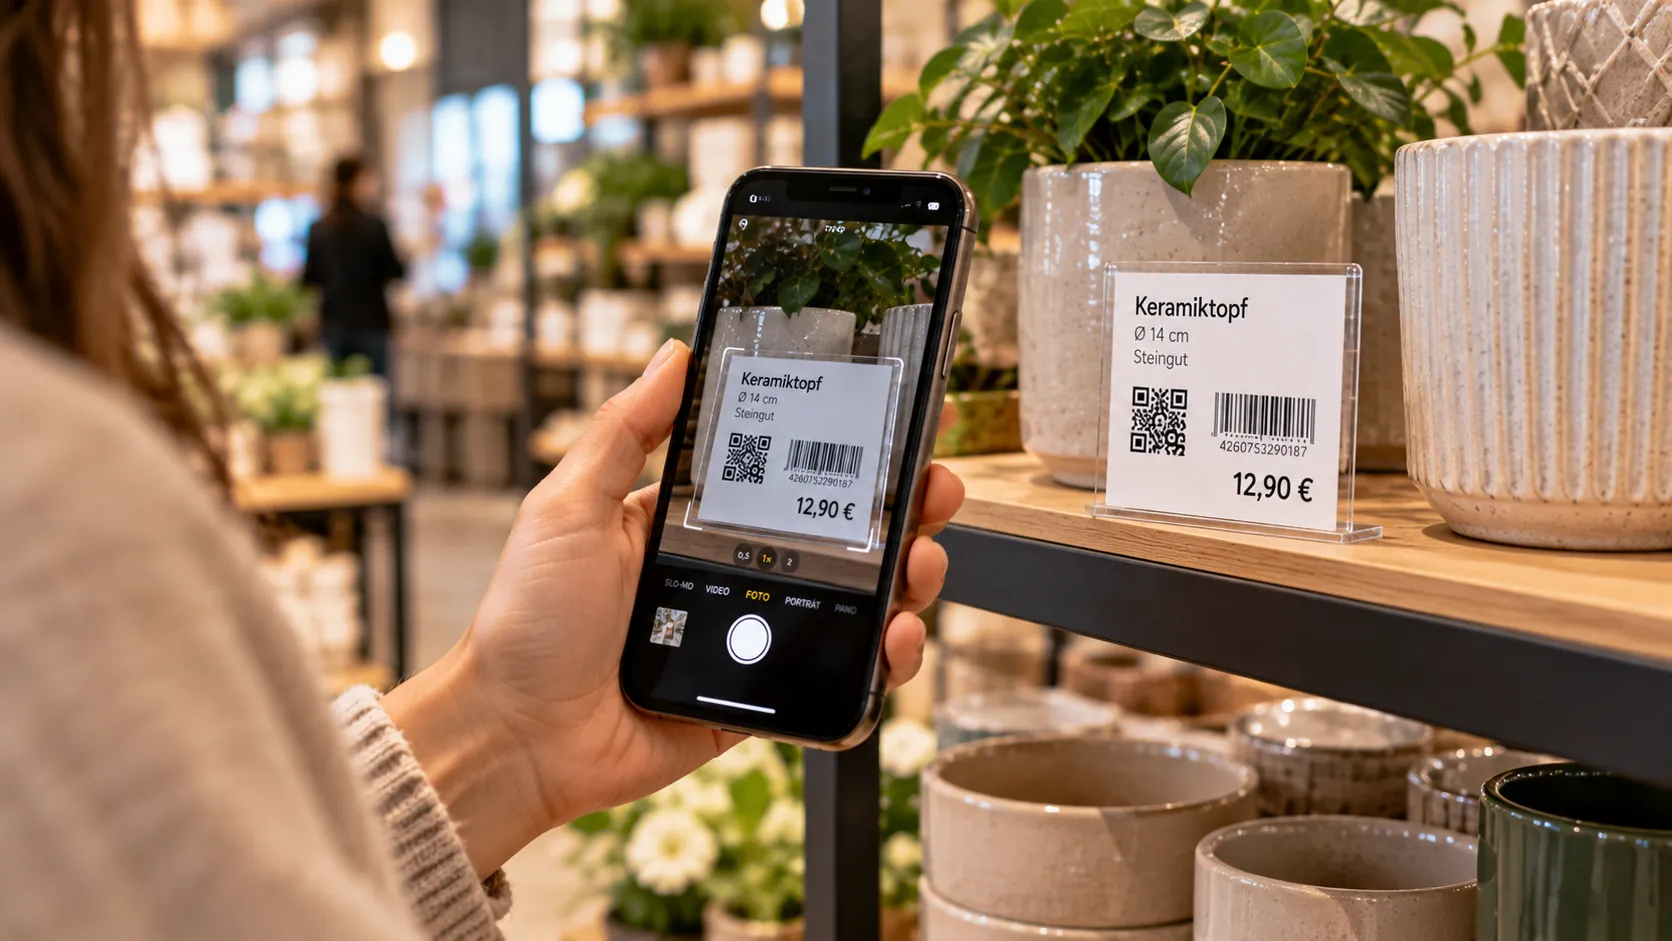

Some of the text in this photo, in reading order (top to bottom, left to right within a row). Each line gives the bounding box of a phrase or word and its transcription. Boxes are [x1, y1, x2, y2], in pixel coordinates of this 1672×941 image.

[1135, 296, 1248, 323] Keramiktopf
[1134, 326, 1189, 343] Ø 14 cm
[1133, 349, 1188, 370] Steingut
[741, 371, 823, 393] Keramiktopf
[750, 393, 760, 403] 14
[762, 395, 778, 405] cm
[734, 407, 775, 423] Steingut
[1233, 472, 1314, 503] 12,90 €
[796, 497, 856, 521] 12,90 €
[762, 553, 773, 563] 1x
[786, 558, 793, 566] 2
[664, 578, 694, 590] SLO-MO
[705, 584, 730, 596] VIDEO
[745, 590, 770, 601] FOTO
